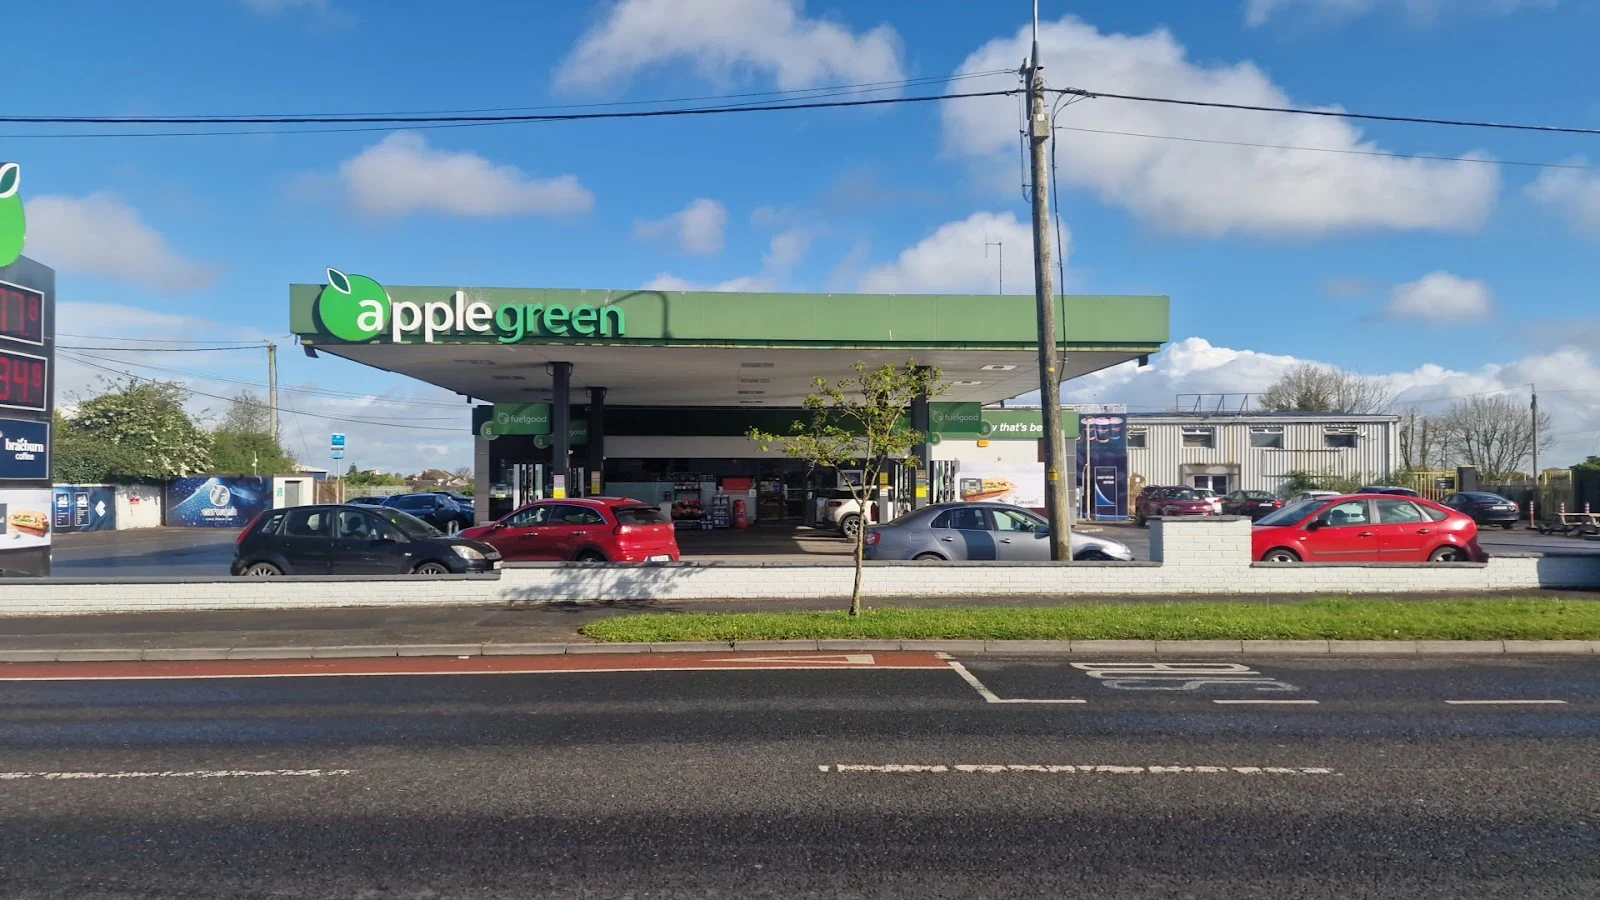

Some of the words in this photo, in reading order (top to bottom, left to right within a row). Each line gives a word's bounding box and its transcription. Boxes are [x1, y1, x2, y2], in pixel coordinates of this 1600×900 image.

[357, 290, 625, 344] applegreen
[510, 415, 547, 424] fuelgood
[944, 413, 979, 423] fuelgood
[999, 423, 1027, 432] that's
[1029, 423, 1044, 432] be
[15, 451, 35, 461] coffee
